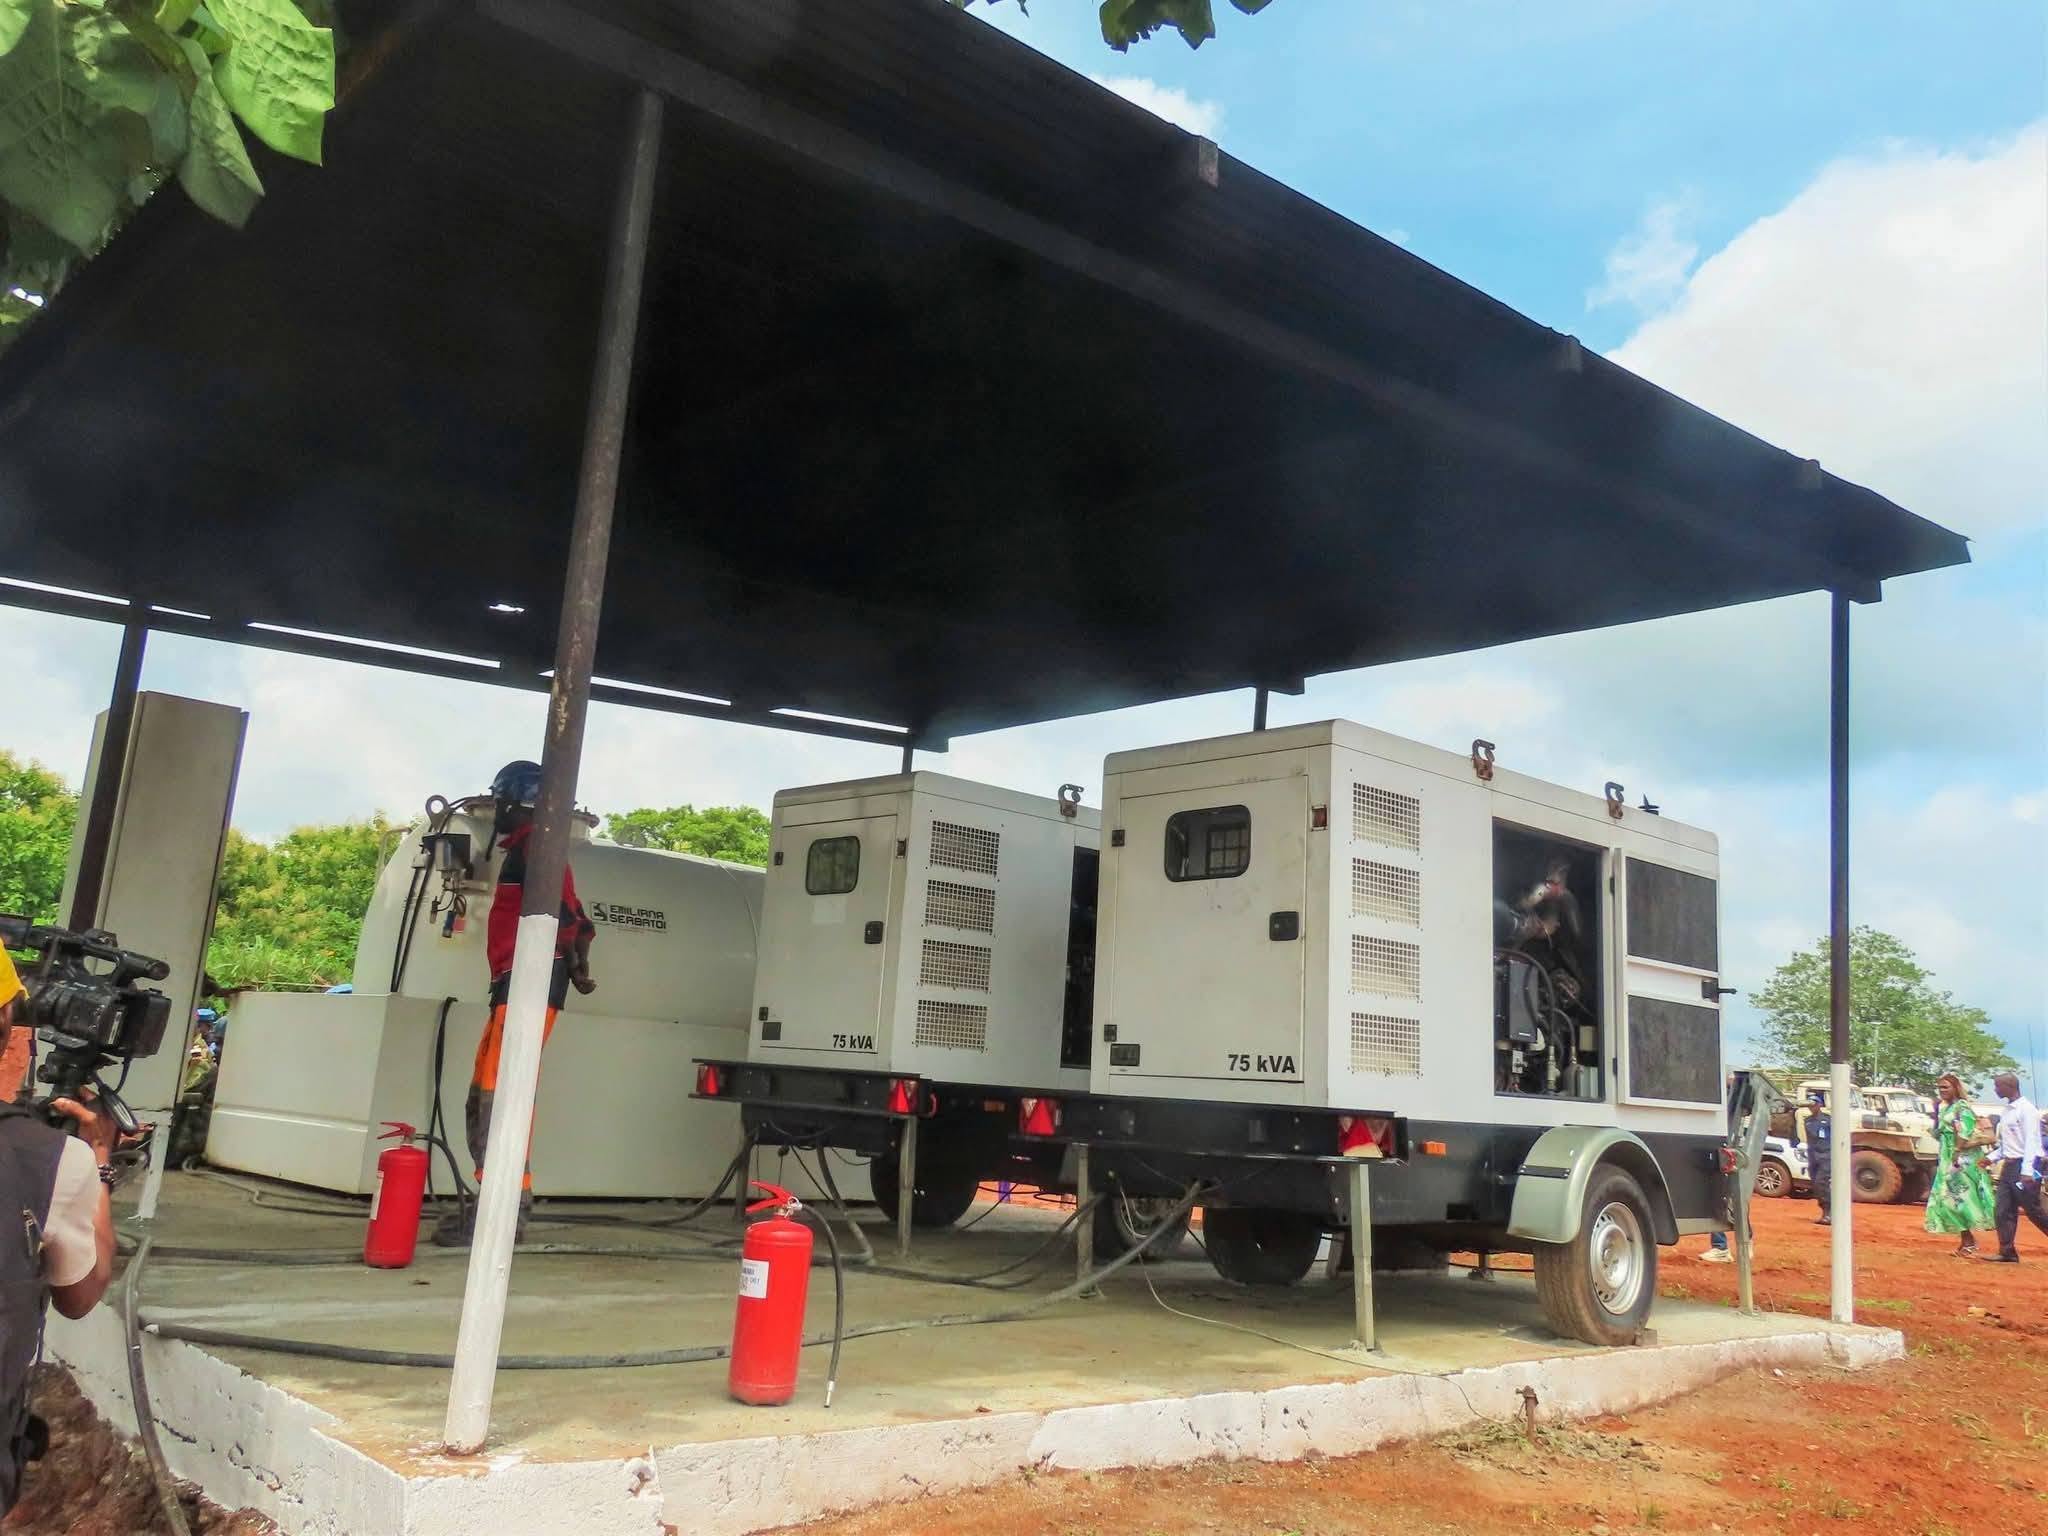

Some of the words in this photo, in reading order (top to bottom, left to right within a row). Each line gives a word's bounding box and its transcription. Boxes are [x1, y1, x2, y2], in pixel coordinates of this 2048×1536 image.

[610, 905, 664, 920] EMILIANA
[609, 914, 666, 929] SERBATOI
[833, 1034, 846, 1049] 75
[849, 1034, 873, 1050] kVA
[1228, 1053, 1250, 1072] 75
[1257, 1054, 1296, 1074] kVA
